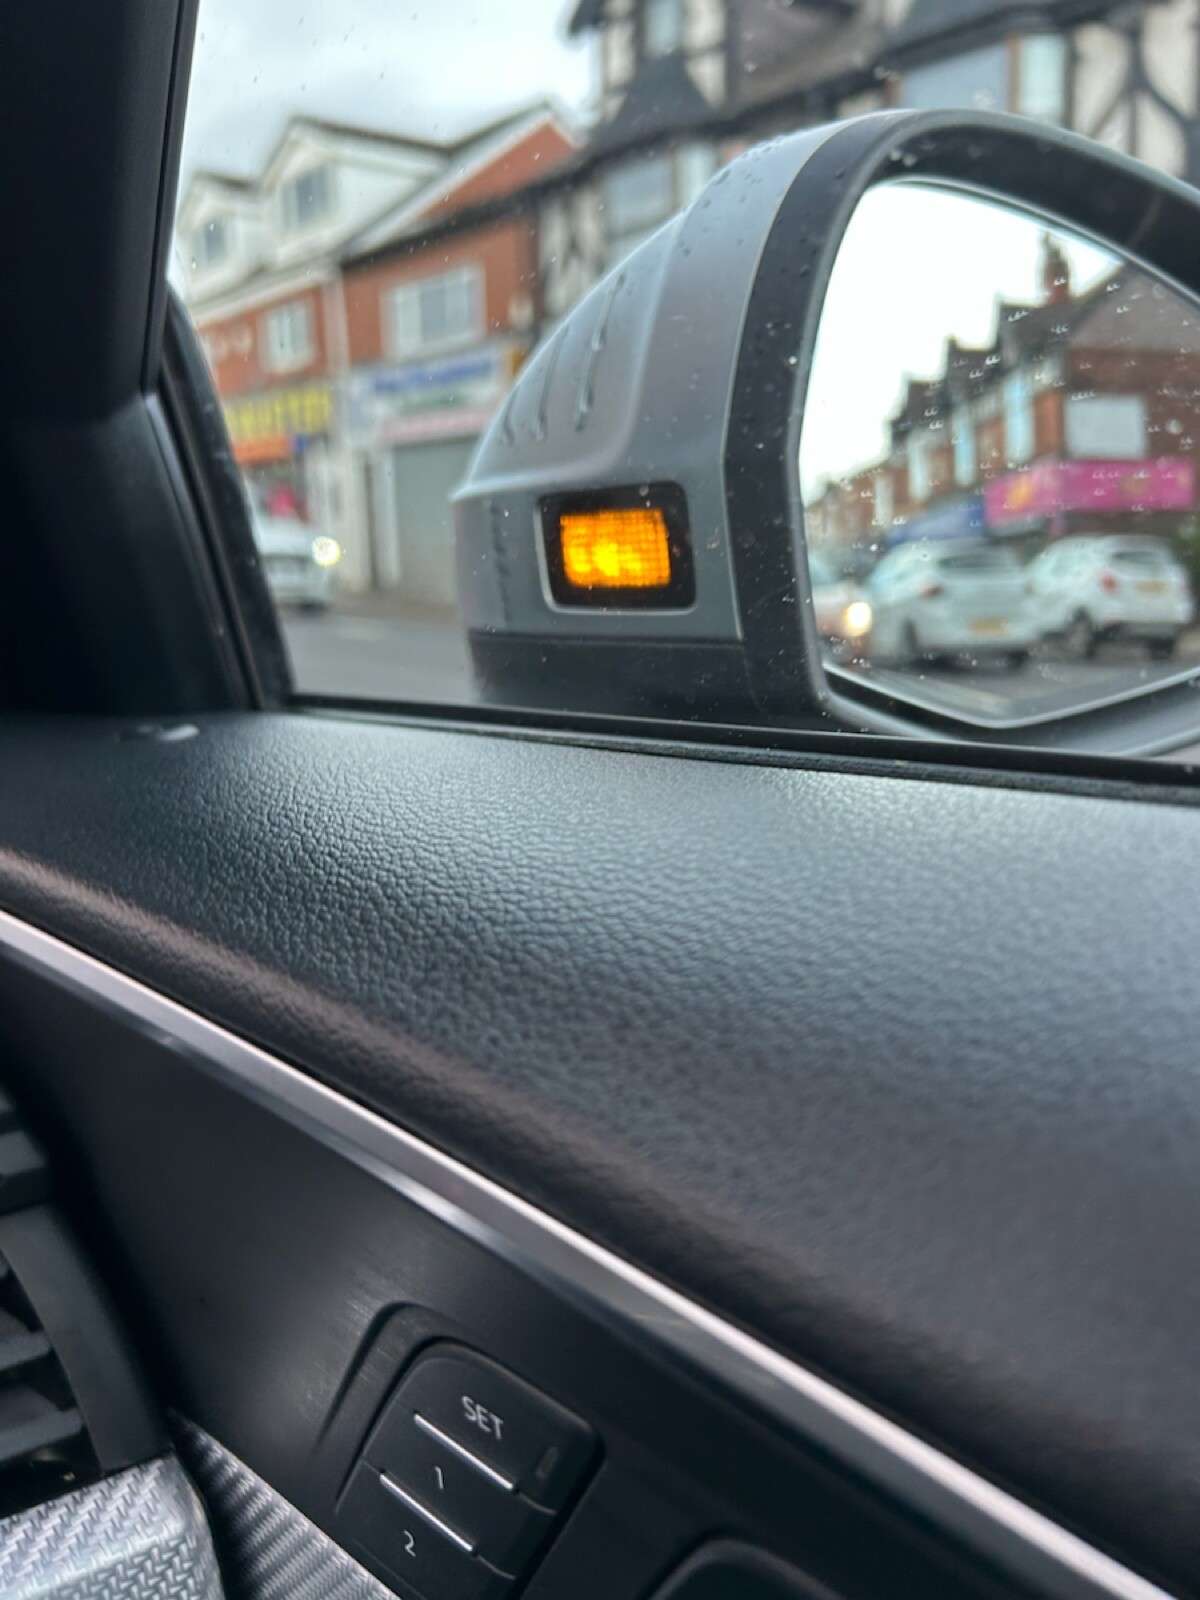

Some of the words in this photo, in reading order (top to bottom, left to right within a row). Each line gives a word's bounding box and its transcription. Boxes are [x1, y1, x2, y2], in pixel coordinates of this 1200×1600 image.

[462, 1395, 503, 1440] SET
[434, 1465, 444, 1489] 1
[403, 1530, 416, 1557] 2
